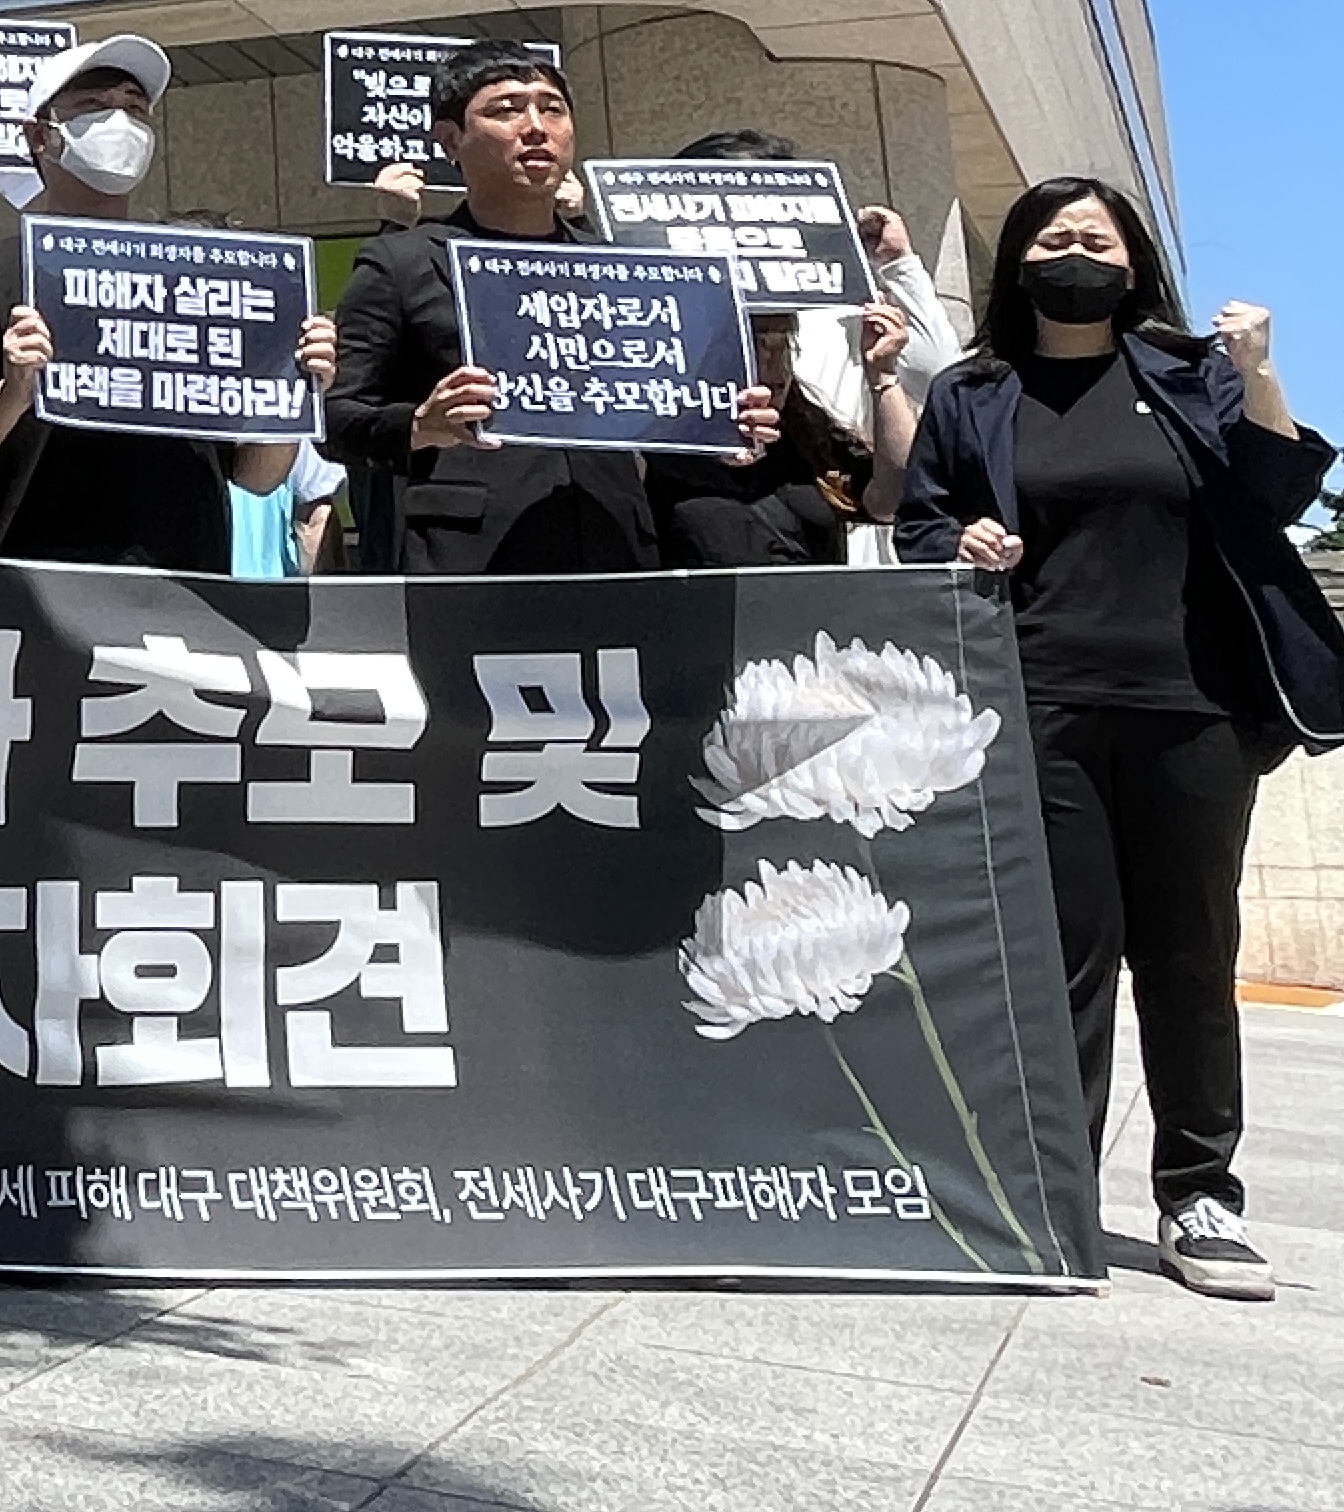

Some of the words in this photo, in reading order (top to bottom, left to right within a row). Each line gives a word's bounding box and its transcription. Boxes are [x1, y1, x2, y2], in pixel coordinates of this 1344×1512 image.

[362, 102, 431, 131] 자신이
[59, 236, 87, 253] 대구
[92, 238, 146, 259] 전세사기
[485, 259, 513, 274] 대구
[63, 268, 167, 312] 피해자
[173, 277, 275, 322] 살리는
[517, 290, 681, 332] 세입자로서
[97, 318, 199, 363] 제대로
[207, 326, 242, 367] 된
[526, 333, 686, 374] 시민으로서
[45, 362, 143, 408] 대책을
[152, 371, 306, 419] 마련하라!
[582, 376, 739, 420] 추모합니다
[72, 634, 431, 829] 추모
[472, 646, 653, 829] 및
[45, 1165, 132, 1221] 피해
[137, 1166, 223, 1221] 대구
[231, 1165, 453, 1225] 대책위원회,
[457, 1166, 630, 1223] 전세사기
[630, 1165, 837, 1223] 대구피해자
[844, 1165, 933, 1221] 모임
